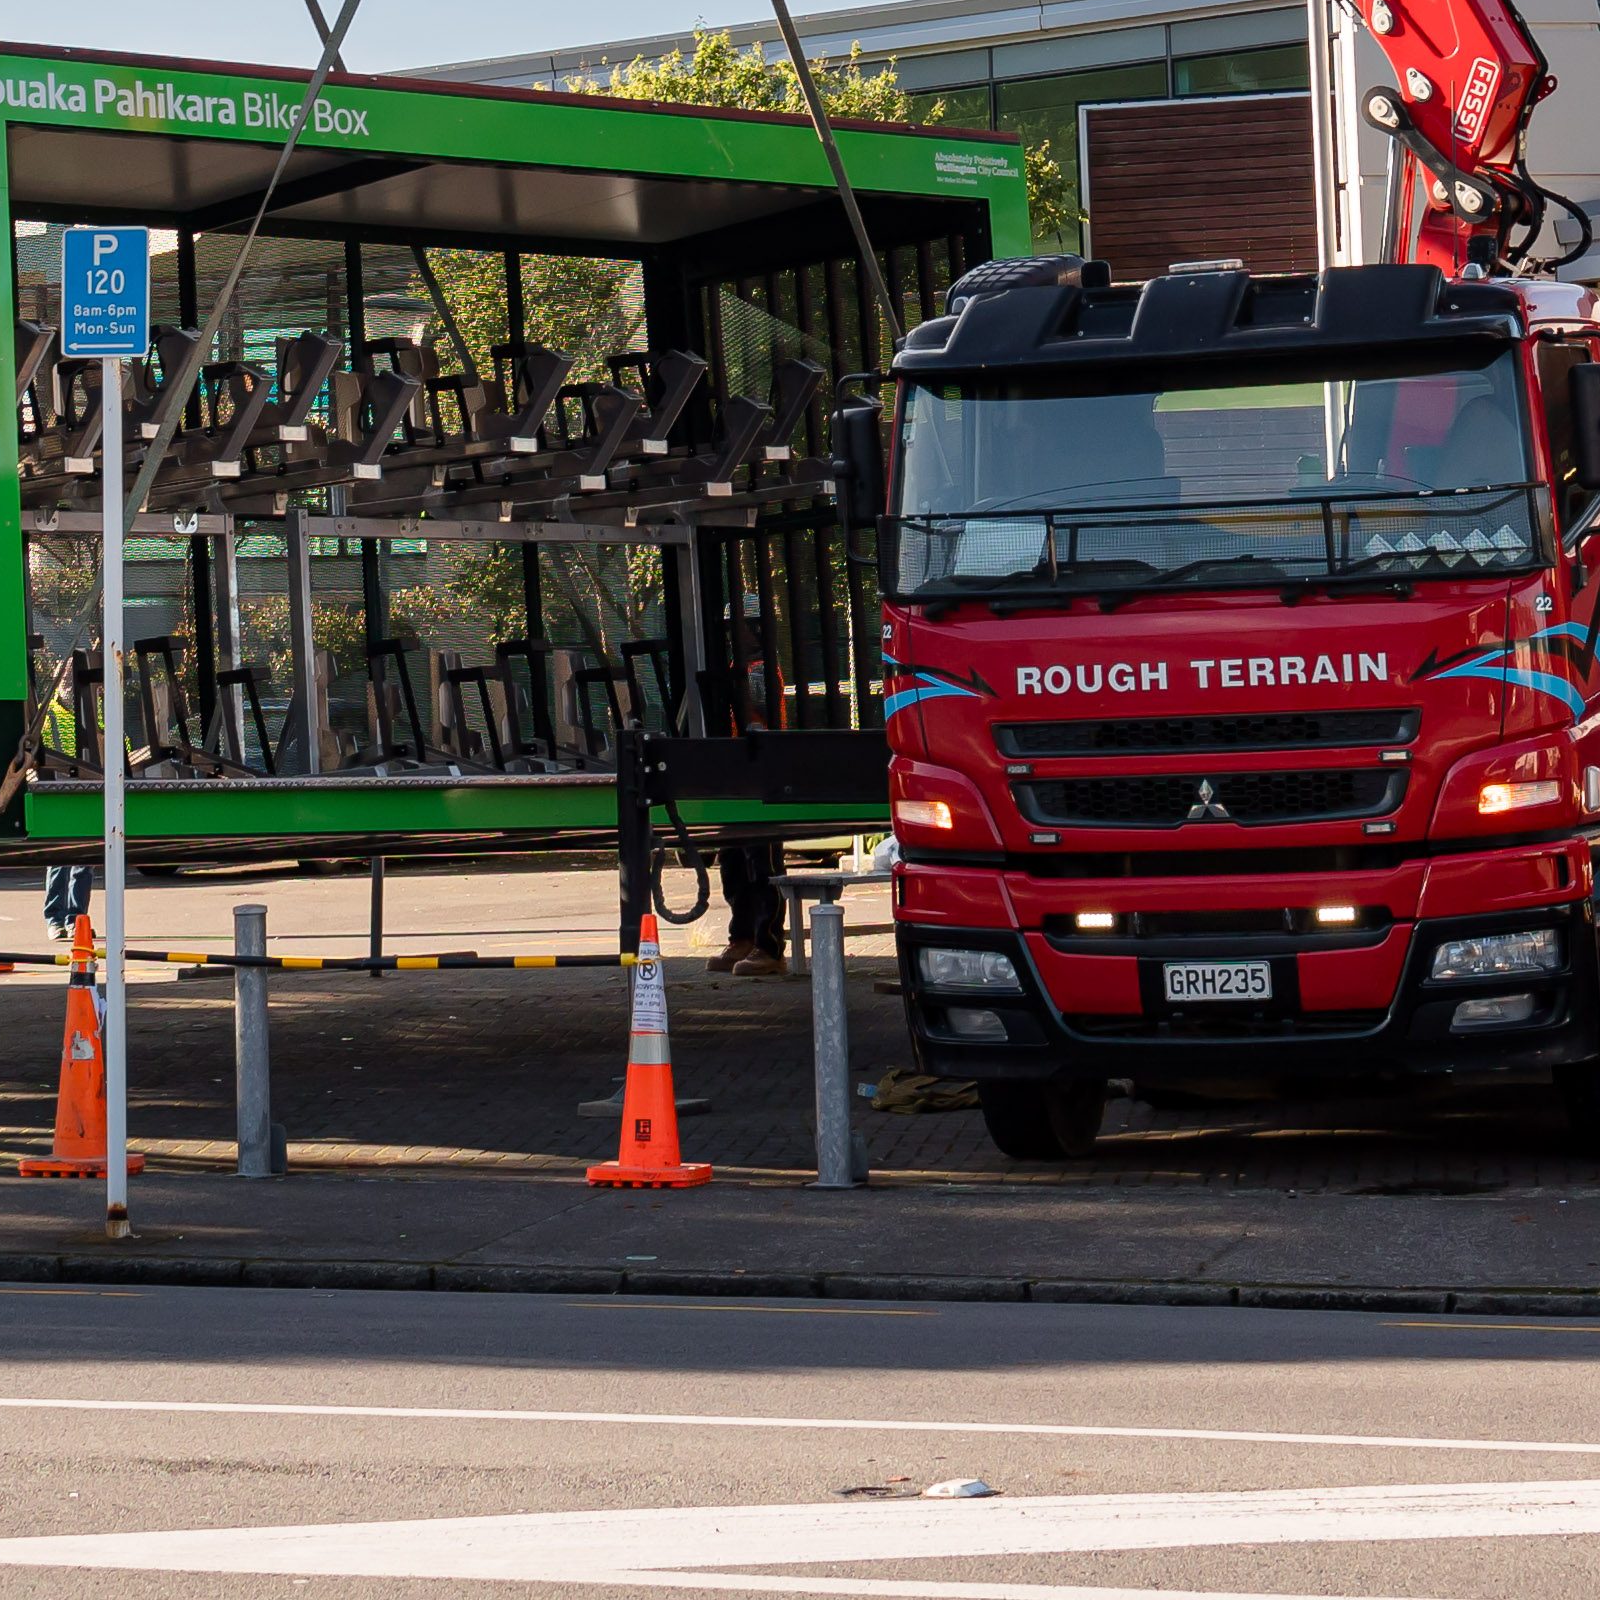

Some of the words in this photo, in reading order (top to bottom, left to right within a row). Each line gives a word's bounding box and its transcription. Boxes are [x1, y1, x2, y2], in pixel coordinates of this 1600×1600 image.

[94, 78, 237, 125] Pahikara
[313, 98, 369, 136] Box
[1457, 65, 1493, 135] FASSI
[977, 165, 992, 177] City
[93, 234, 119, 266] P
[86, 269, 125, 295] 120
[73, 304, 137, 318] 8am-6pm
[74, 322, 136, 335] Mon-Sun
[1535, 596, 1553, 612] 22
[1017, 662, 1169, 695] ROUGH
[1190, 652, 1389, 689] TERRAIN
[1169, 968, 1266, 995] GRH235
